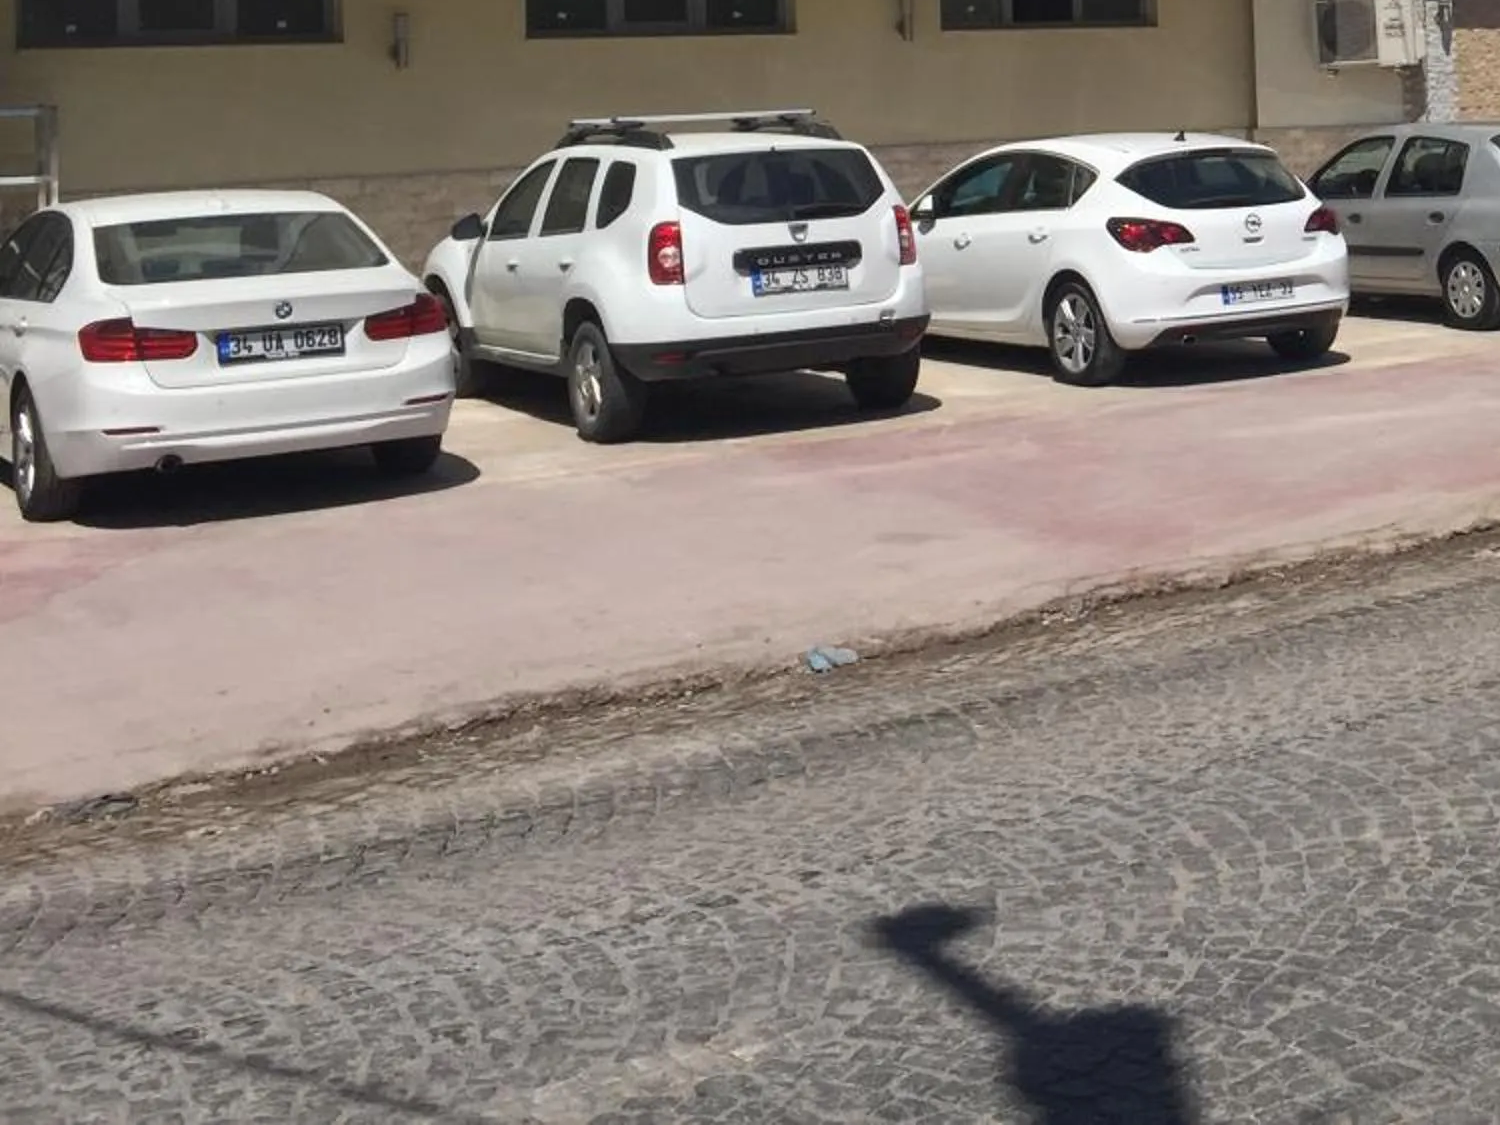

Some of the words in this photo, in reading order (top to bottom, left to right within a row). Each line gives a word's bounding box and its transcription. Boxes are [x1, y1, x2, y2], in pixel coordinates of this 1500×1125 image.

[230, 336, 253, 355] 34
[261, 334, 284, 352] UA
[294, 329, 340, 349] 0628
